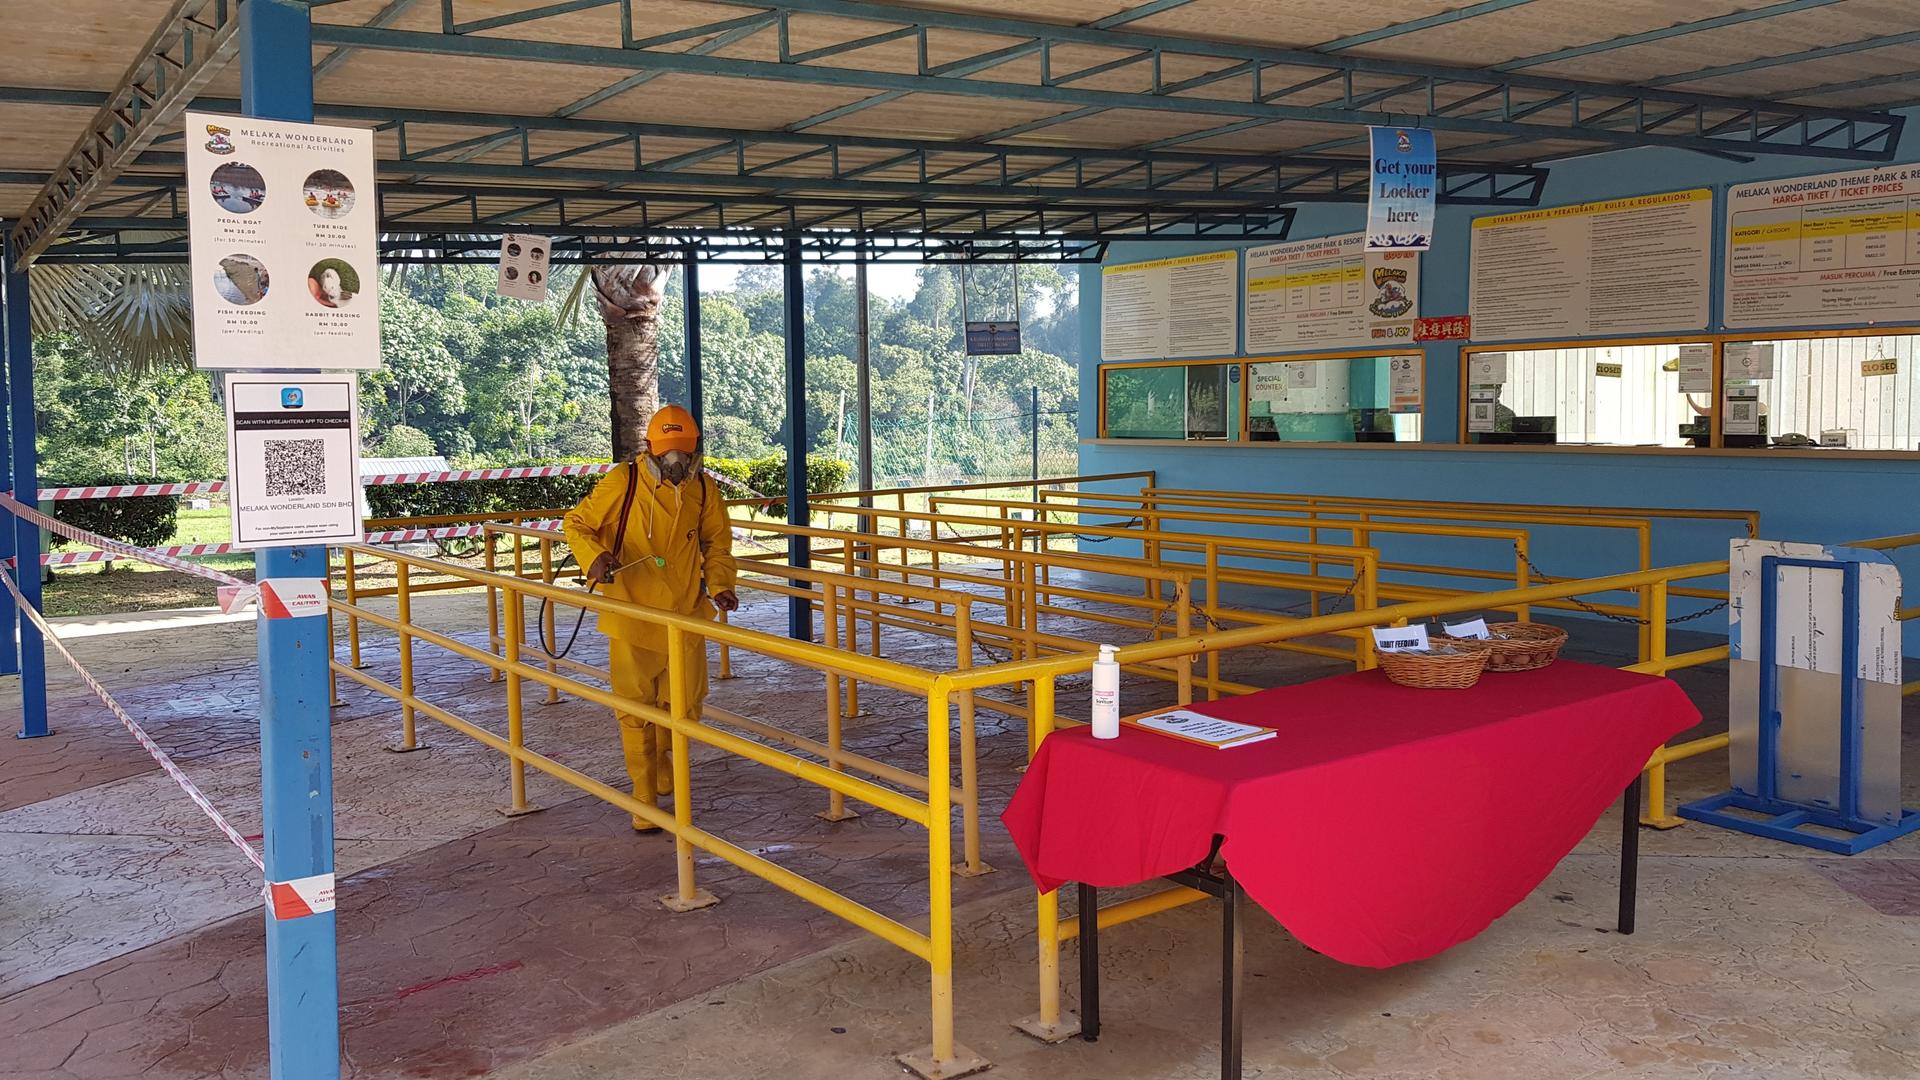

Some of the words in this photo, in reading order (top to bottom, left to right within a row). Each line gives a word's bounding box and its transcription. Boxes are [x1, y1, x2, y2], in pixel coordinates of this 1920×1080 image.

[241, 129, 281, 139] MELAKA
[285, 133, 354, 146] WONDERLAND
[251, 139, 303, 149] Recreational
[307, 144, 345, 153] Activities
[1375, 158, 1401, 175] Get
[1403, 162, 1435, 179] your
[1380, 182, 1430, 199] Locker
[1736, 187, 1770, 199] MELAKA
[1773, 179, 1837, 194] WONDERLAND
[1840, 175, 1870, 187] THEME
[1873, 172, 1897, 183] PARK
[1900, 171, 1907, 180] &
[1772, 194, 1804, 204] HARGA
[1807, 190, 1829, 200] TIKET
[1840, 186, 1870, 197] TICKET
[1872, 182, 1903, 193] PRICES
[1605, 201, 1626, 209] RULES
[1638, 192, 1691, 205] REGULATIONS
[1387, 206, 1419, 223] here
[1374, 267, 1407, 278] MELAKA
[1394, 326, 1410, 337] JOY
[1596, 365, 1621, 374] CLOSED
[1863, 362, 1896, 372] CLOSED
[1256, 383, 1283, 391] COUNTER
[240, 504, 269, 512] MELAKA
[270, 502, 321, 511] WONDERLAND
[1395, 638, 1420, 648] FEEDING
